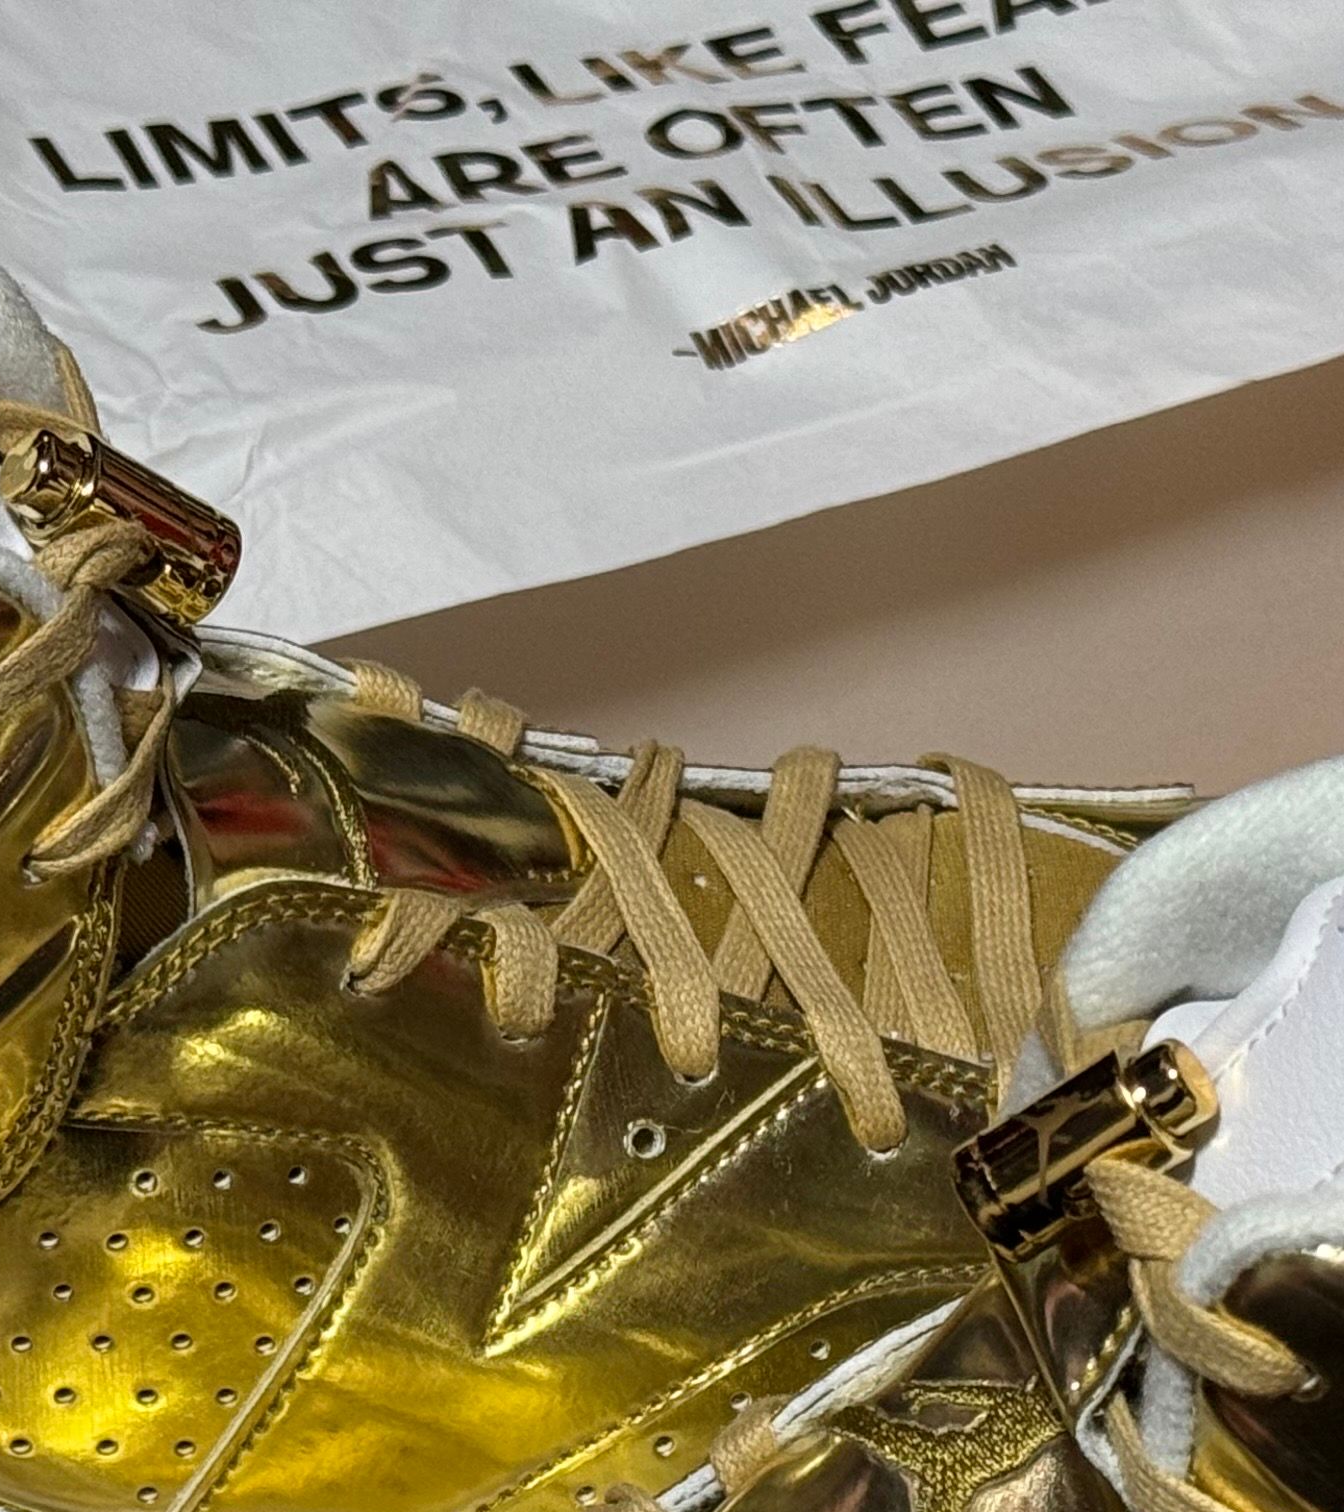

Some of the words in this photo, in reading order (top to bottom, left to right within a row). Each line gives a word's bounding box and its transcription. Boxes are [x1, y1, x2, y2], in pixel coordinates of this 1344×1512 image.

[28, 72, 509, 193] LIMITS,
[508, 26, 806, 104] LIKE
[811, 0, 1106, 65] FEA
[368, 134, 629, 220] ARE
[645, 66, 1076, 160] OFTEN
[196, 220, 514, 335] JUST
[570, 179, 752, 266] AN
[865, 243, 1019, 305] JORDAN
